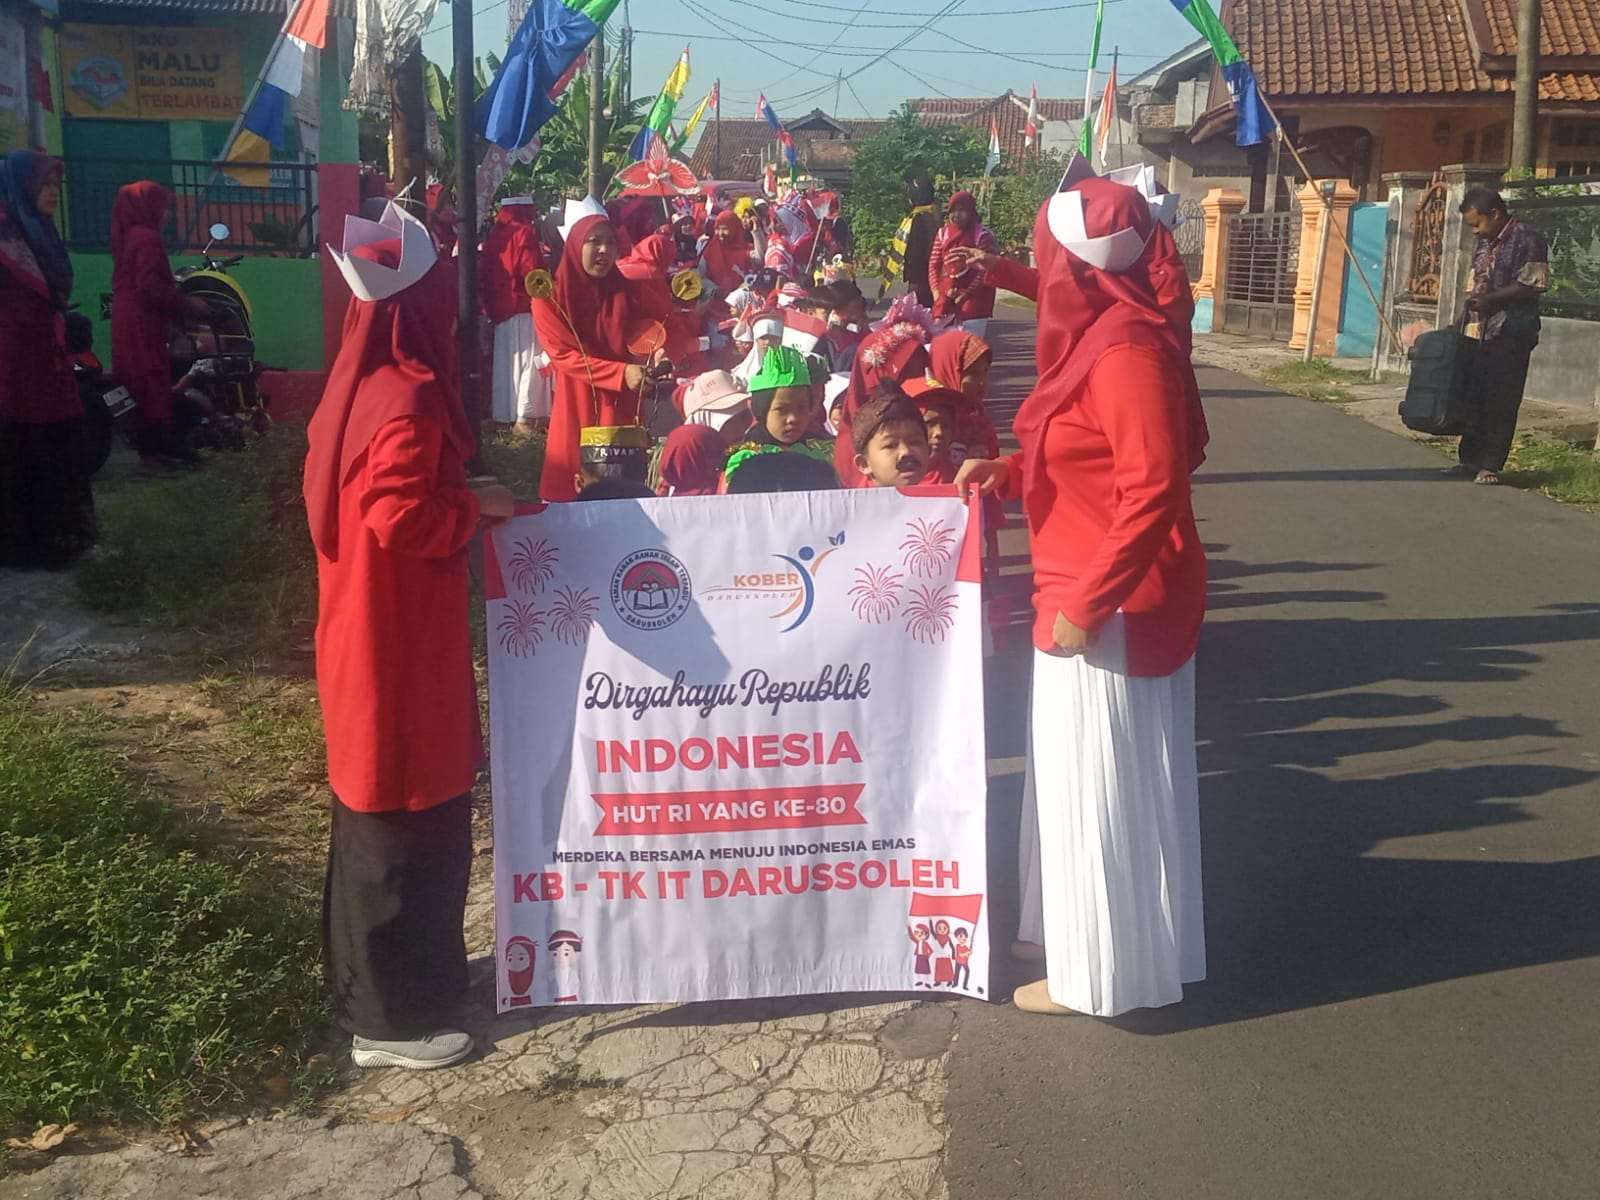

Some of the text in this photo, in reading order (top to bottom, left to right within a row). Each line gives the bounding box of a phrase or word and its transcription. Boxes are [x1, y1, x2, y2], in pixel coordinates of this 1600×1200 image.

[139, 51, 221, 72] MALU
[140, 76, 215, 88] BILA DATANG
[142, 93, 243, 110] TERLAMBAT
[733, 572, 799, 588] KOBER
[584, 662, 871, 721] Dirgahayu Republik
[596, 731, 863, 774] INDONESIA
[612, 796, 847, 824] HUT RI YANG KE-80
[552, 837, 916, 863] MERDEKA BERSAMA MENUJU INDONESIA EMAS
[513, 872, 564, 904] KB
[598, 871, 647, 901] TK
[657, 870, 691, 899] IT
[703, 859, 960, 899] DARUSSOLEH
